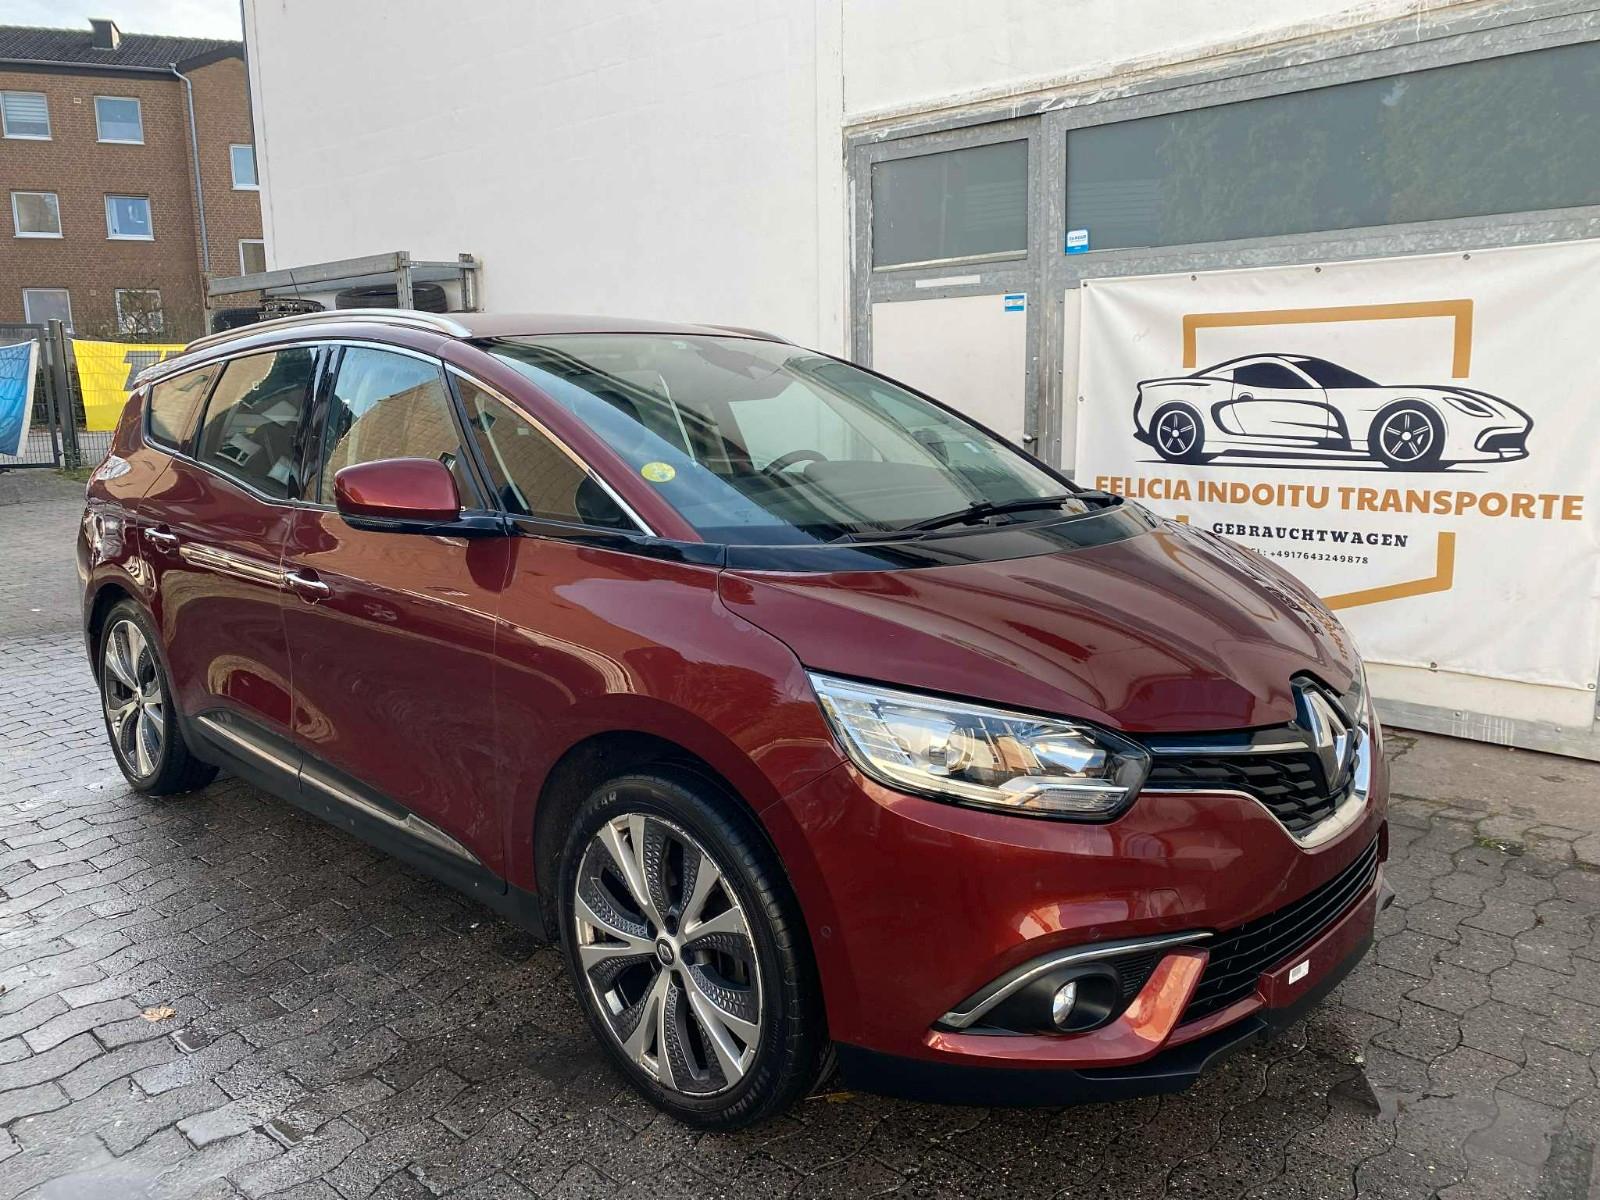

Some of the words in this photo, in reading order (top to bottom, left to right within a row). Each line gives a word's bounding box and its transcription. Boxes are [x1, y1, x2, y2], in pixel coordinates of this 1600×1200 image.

[1095, 476, 1192, 501] FELICIA
[1198, 480, 1330, 509] INDOITU
[1337, 487, 1585, 521] TRANSPORTE
[1212, 522, 1409, 548] GEBRAUCHTWAGEN
[1270, 549, 1369, 565] +4917643249878
